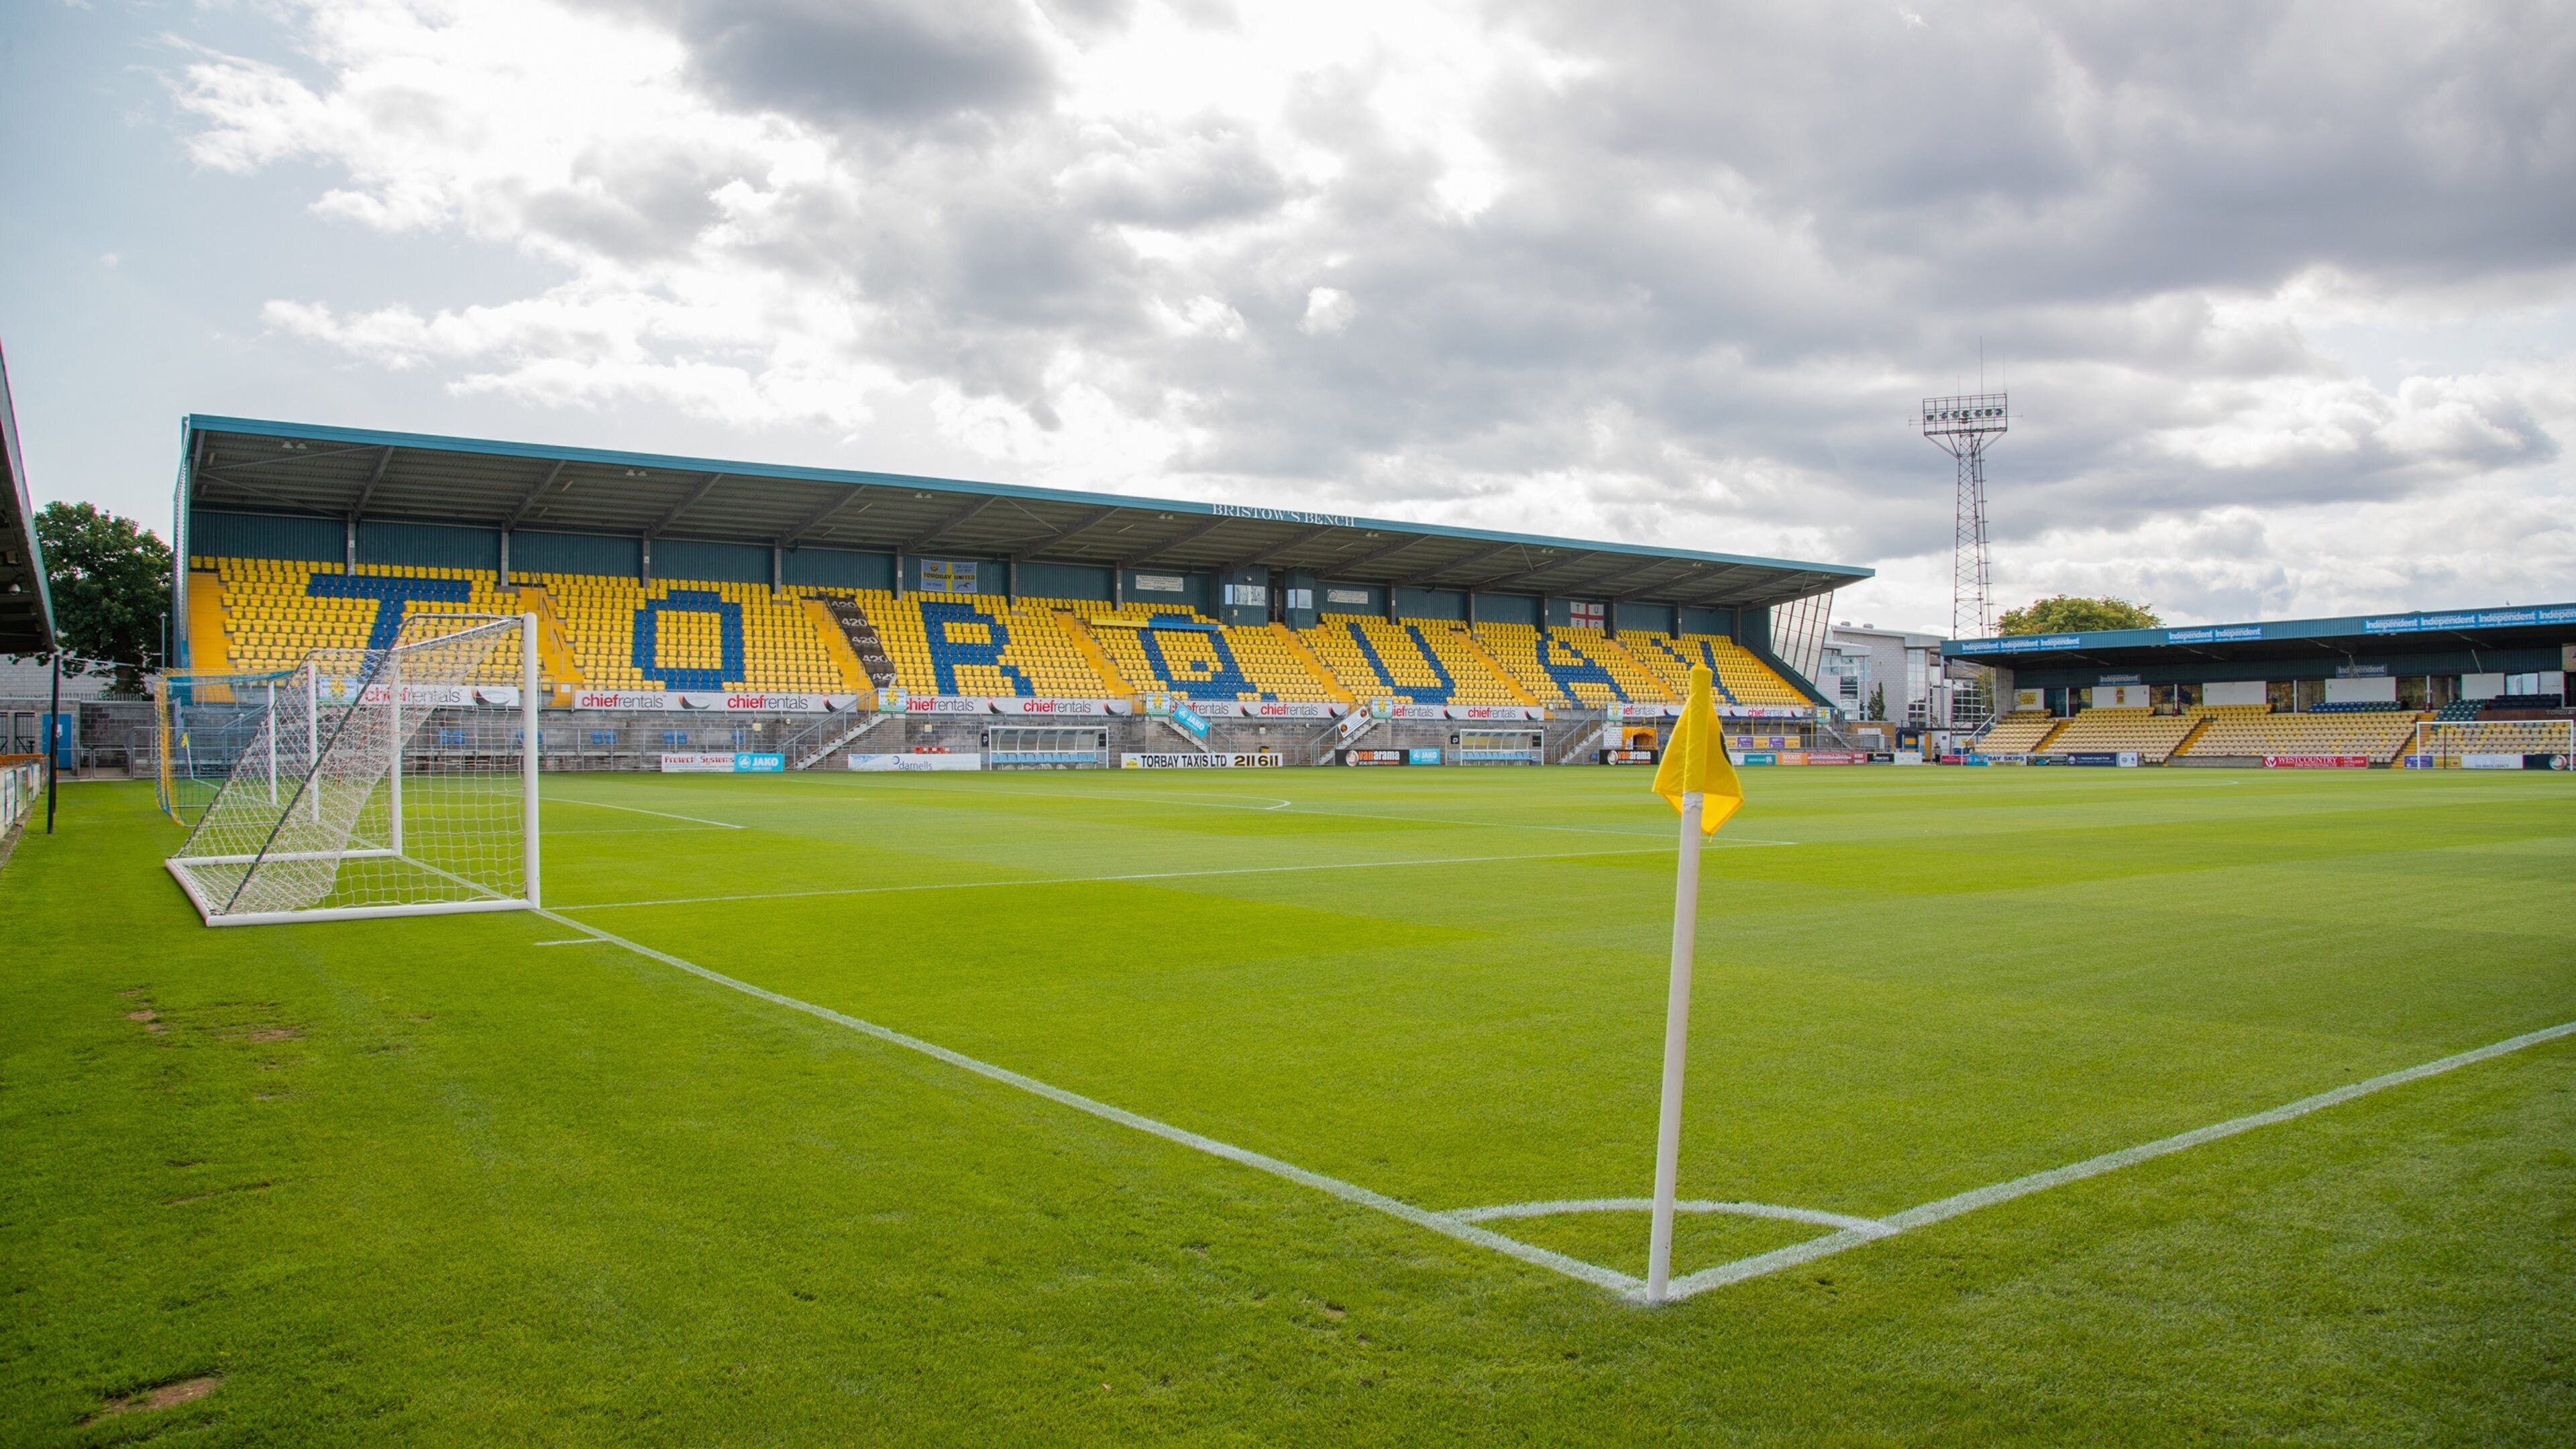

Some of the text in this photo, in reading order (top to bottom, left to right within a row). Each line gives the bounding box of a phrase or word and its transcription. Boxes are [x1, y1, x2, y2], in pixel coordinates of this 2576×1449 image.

[1212, 503, 1355, 527] BRISTOW'S BENCH
[1576, 604, 1599, 614] T U
[2420, 614, 2475, 626] Independent
[2478, 611, 2536, 623] Independent
[841, 618, 867, 627] 420
[2366, 619, 2418, 630] Independent
[2169, 631, 2213, 641] Independent
[2215, 627, 2261, 638] Independent
[851, 636, 877, 644] 420
[2000, 640, 2039, 649] Independent
[2041, 637, 2080, 647] Independent
[1962, 642, 1999, 651] Independent
[2100, 675, 2139, 684] Independent
[582, 694, 663, 708] chiefrentals
[727, 694, 808, 710] chiefrentals
[1023, 699, 1091, 713] chiefrentals
[1260, 704, 1318, 716] chiefrentals
[1468, 707, 1515, 718] chiefrentals
[1623, 705, 1656, 716] iefrentals
[1748, 708, 1784, 717] chiefrentals
[1187, 714, 1205, 731] JAKO
[1358, 751, 1400, 761] vanarama
[1618, 751, 1651, 760] vanarama
[753, 757, 779, 766] JAKO
[898, 761, 932, 770] darnells
[1141, 755, 1179, 768] TORBAY
[1181, 755, 1208, 767] TAXIS
[1210, 755, 1227, 767] LTD
[1234, 755, 1254, 767] 211
[1258, 755, 1279, 767] 611
